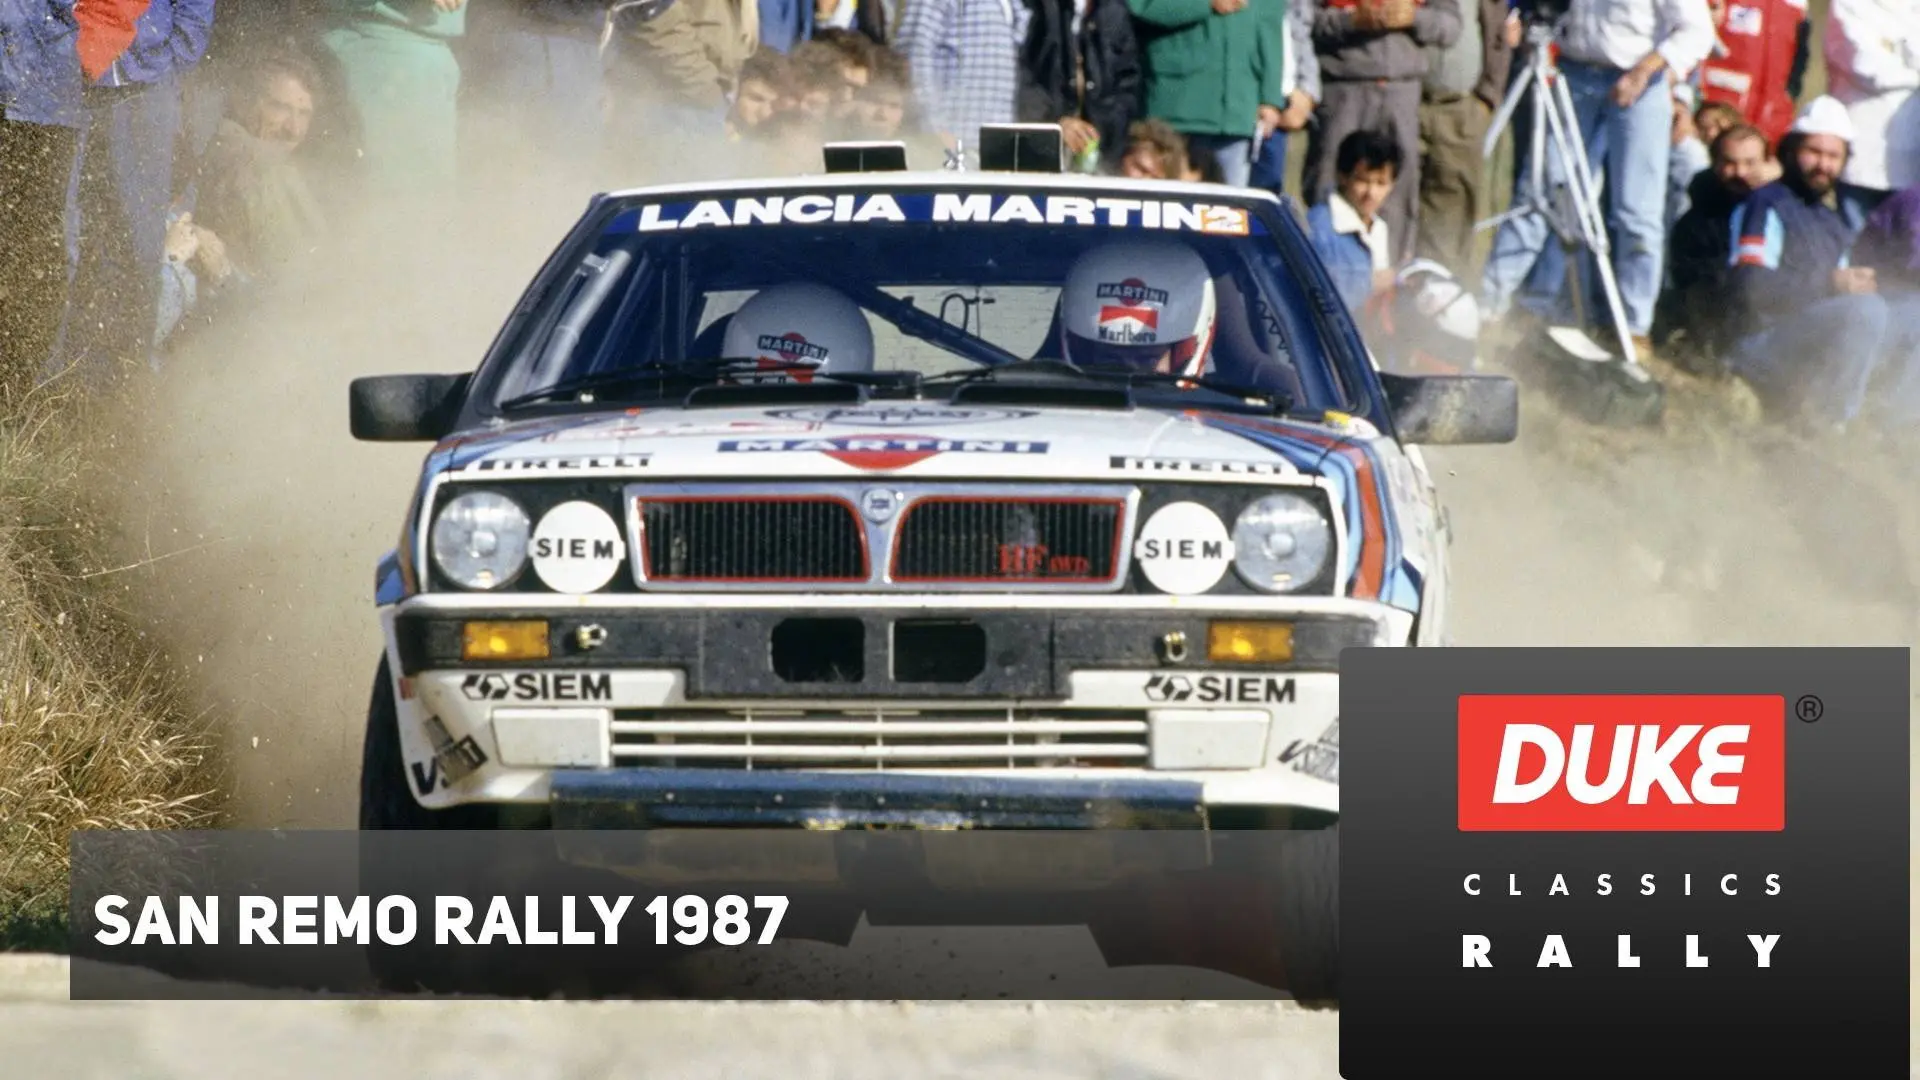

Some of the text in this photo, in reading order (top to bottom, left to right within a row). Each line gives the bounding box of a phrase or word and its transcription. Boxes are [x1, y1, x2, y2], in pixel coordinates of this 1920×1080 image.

[638, 194, 906, 231] LANCIA
[1099, 284, 1168, 305] MARTINI
[1098, 323, 1157, 343] Marlboro
[759, 336, 828, 360] MARTINI
[730, 440, 1038, 453] MARTINI
[536, 538, 614, 559] SIEM
[998, 544, 1048, 574] HF
[1145, 539, 1222, 559] SIEM
[514, 673, 612, 700] SIEM
[1197, 676, 1296, 704] SIEM
